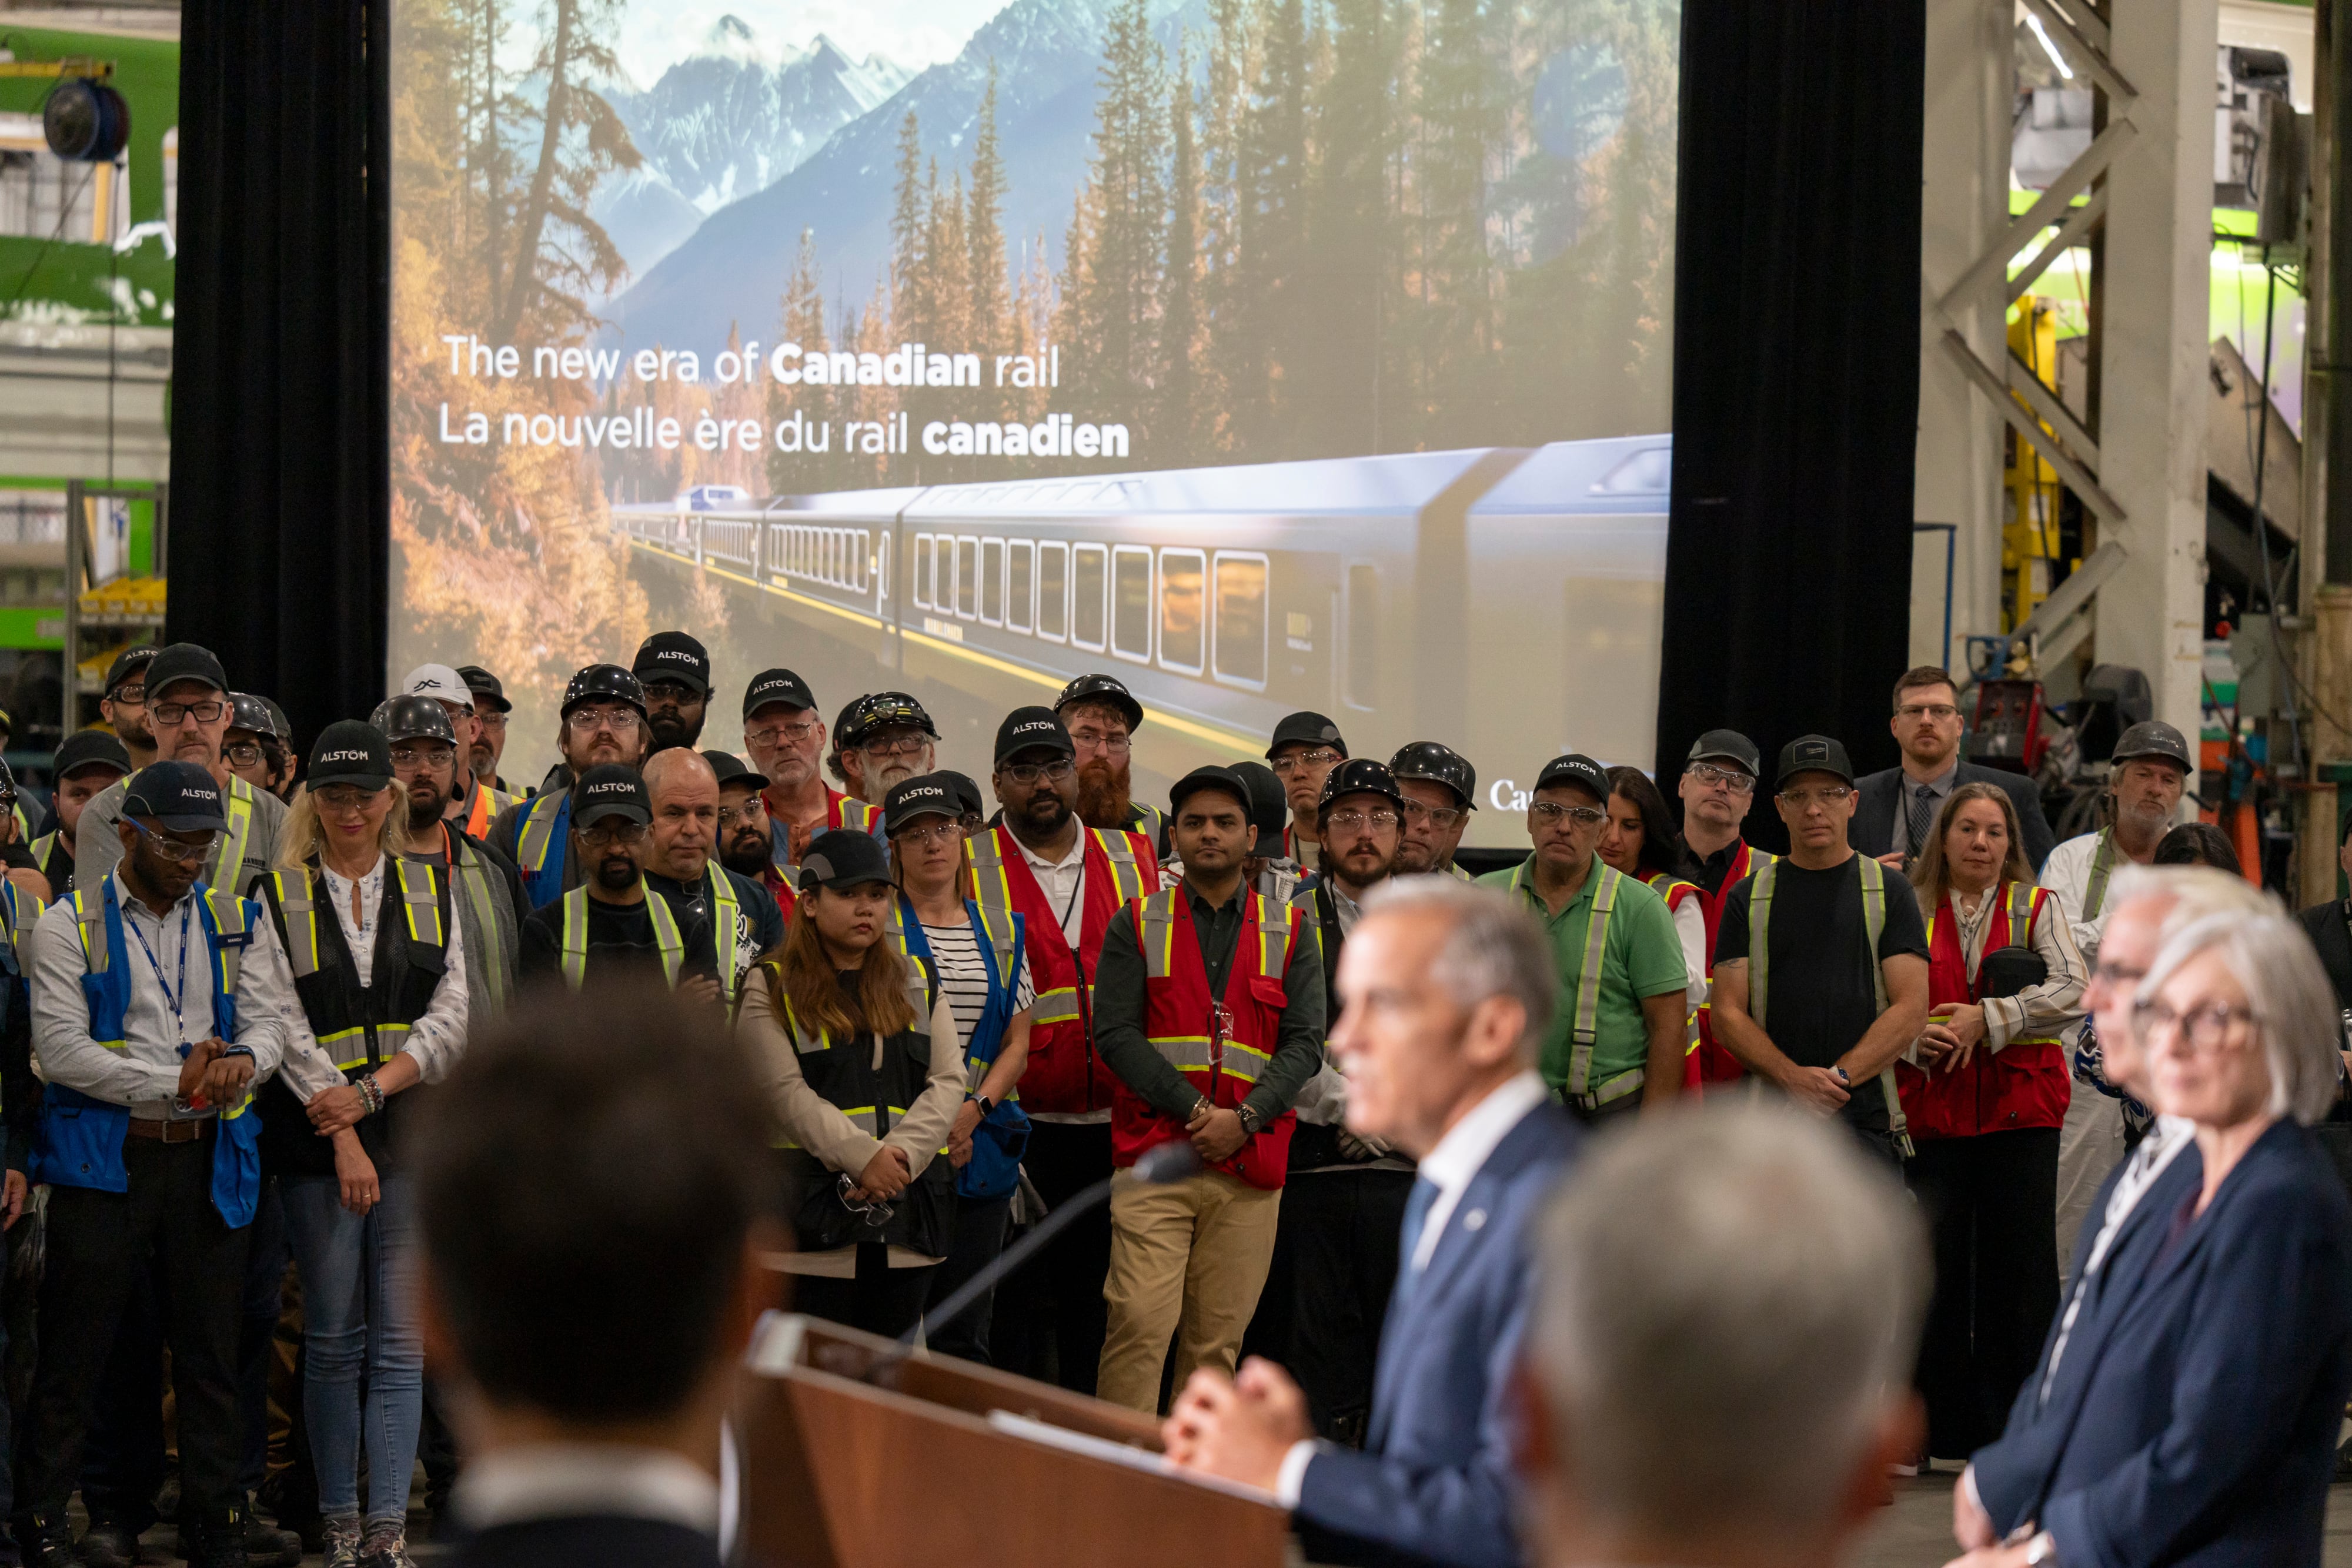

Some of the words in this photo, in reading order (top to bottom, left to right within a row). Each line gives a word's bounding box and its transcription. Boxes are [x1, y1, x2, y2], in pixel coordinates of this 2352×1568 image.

[442, 334, 520, 378] The
[534, 346, 620, 381] new
[634, 349, 699, 384] era
[714, 340, 759, 385] of
[770, 342, 981, 387] Canadian
[995, 343, 1059, 388] rail
[440, 402, 489, 444] La
[503, 406, 681, 449] nouvelle
[694, 408, 763, 452] ère
[774, 409, 830, 453] du
[845, 412, 908, 454] rail
[922, 413, 1130, 457] canadien
[125, 650, 159, 661] ALSTO
[657, 651, 699, 666] ALSTOM
[753, 678, 793, 696] ALSTOM
[1098, 680, 1125, 693] ALSTOM
[1013, 721, 1056, 735] ALSTOM
[320, 750, 369, 763] ALSTOM
[1555, 761, 1597, 776] ALSTOM
[181, 788, 217, 800] ALSTOM
[587, 782, 636, 794] ALSTOM
[898, 786, 944, 805] ALSTOM
